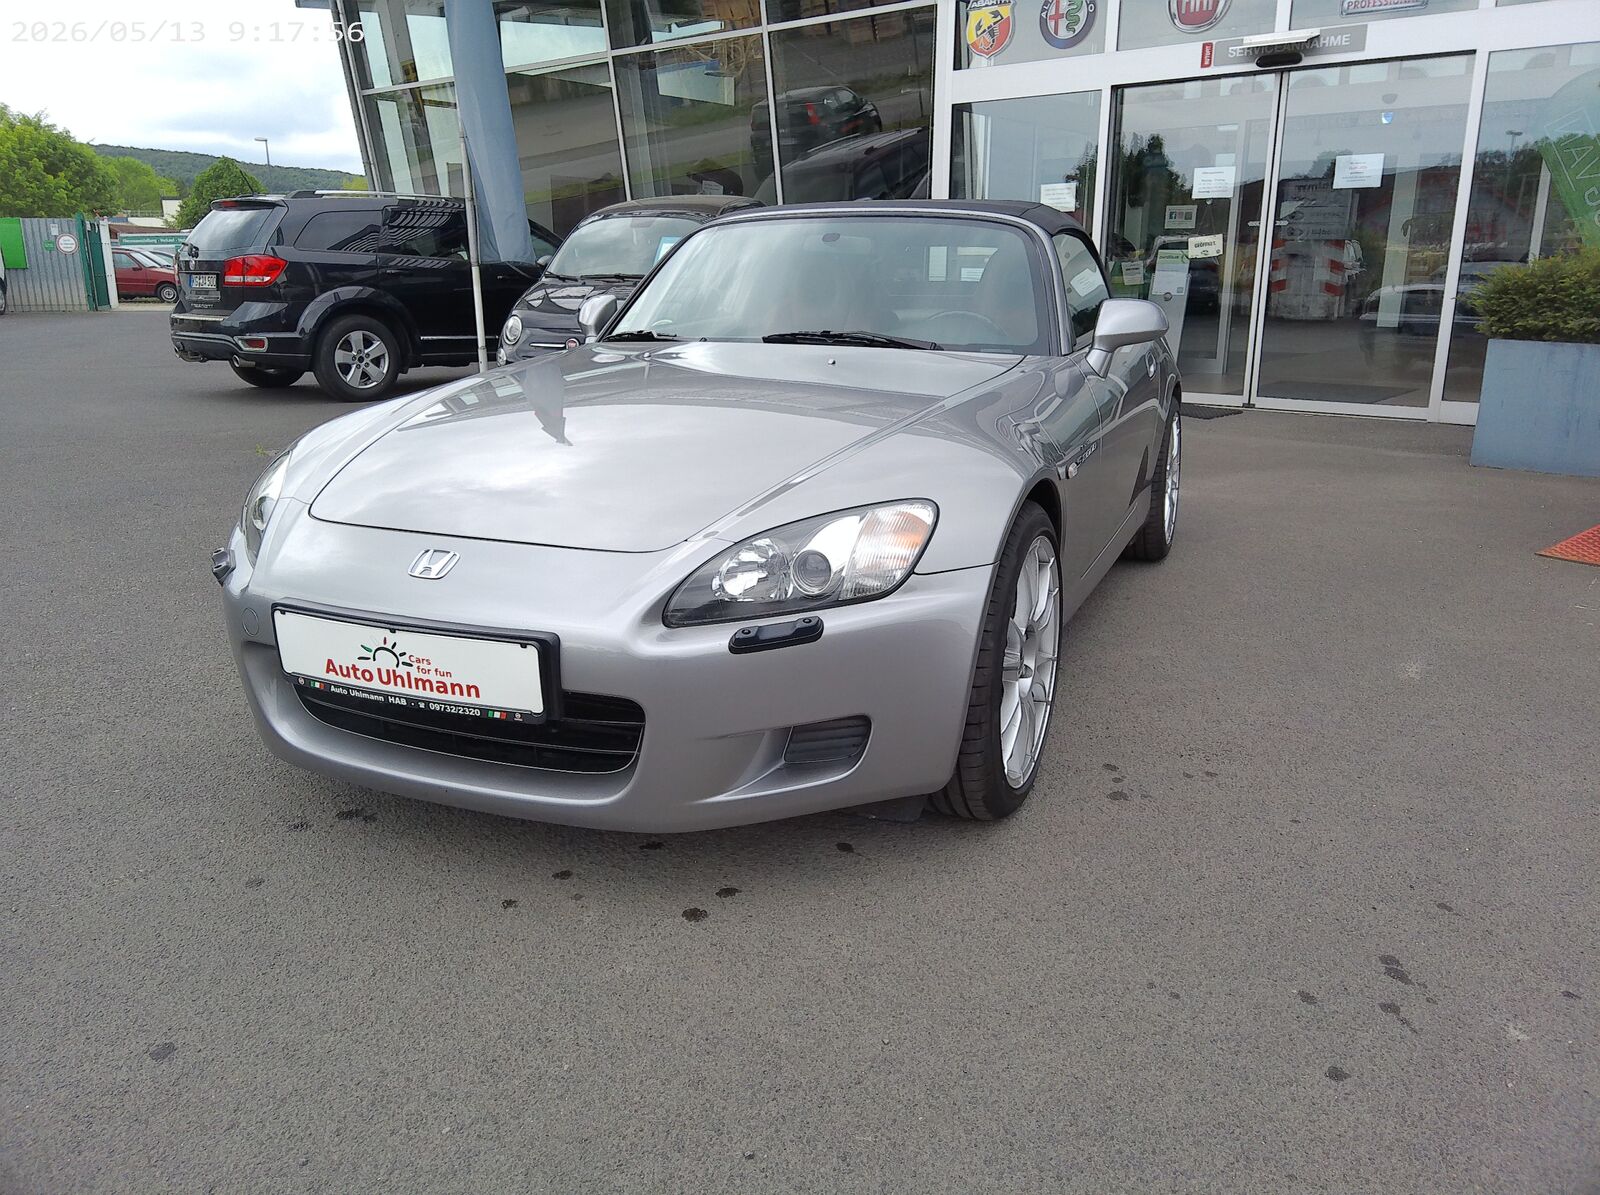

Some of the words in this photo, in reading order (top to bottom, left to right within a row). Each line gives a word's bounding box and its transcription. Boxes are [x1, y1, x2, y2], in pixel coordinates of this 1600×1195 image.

[408, 654, 432, 666] Cars
[325, 658, 374, 683] Auto
[377, 667, 481, 699] Uhlmann
[416, 665, 432, 675] for
[434, 667, 453, 679] fun
[330, 685, 348, 695] Auto
[349, 689, 385, 702] Uhlmann
[388, 695, 407, 706] HAB
[429, 702, 481, 717] 09732/2320
